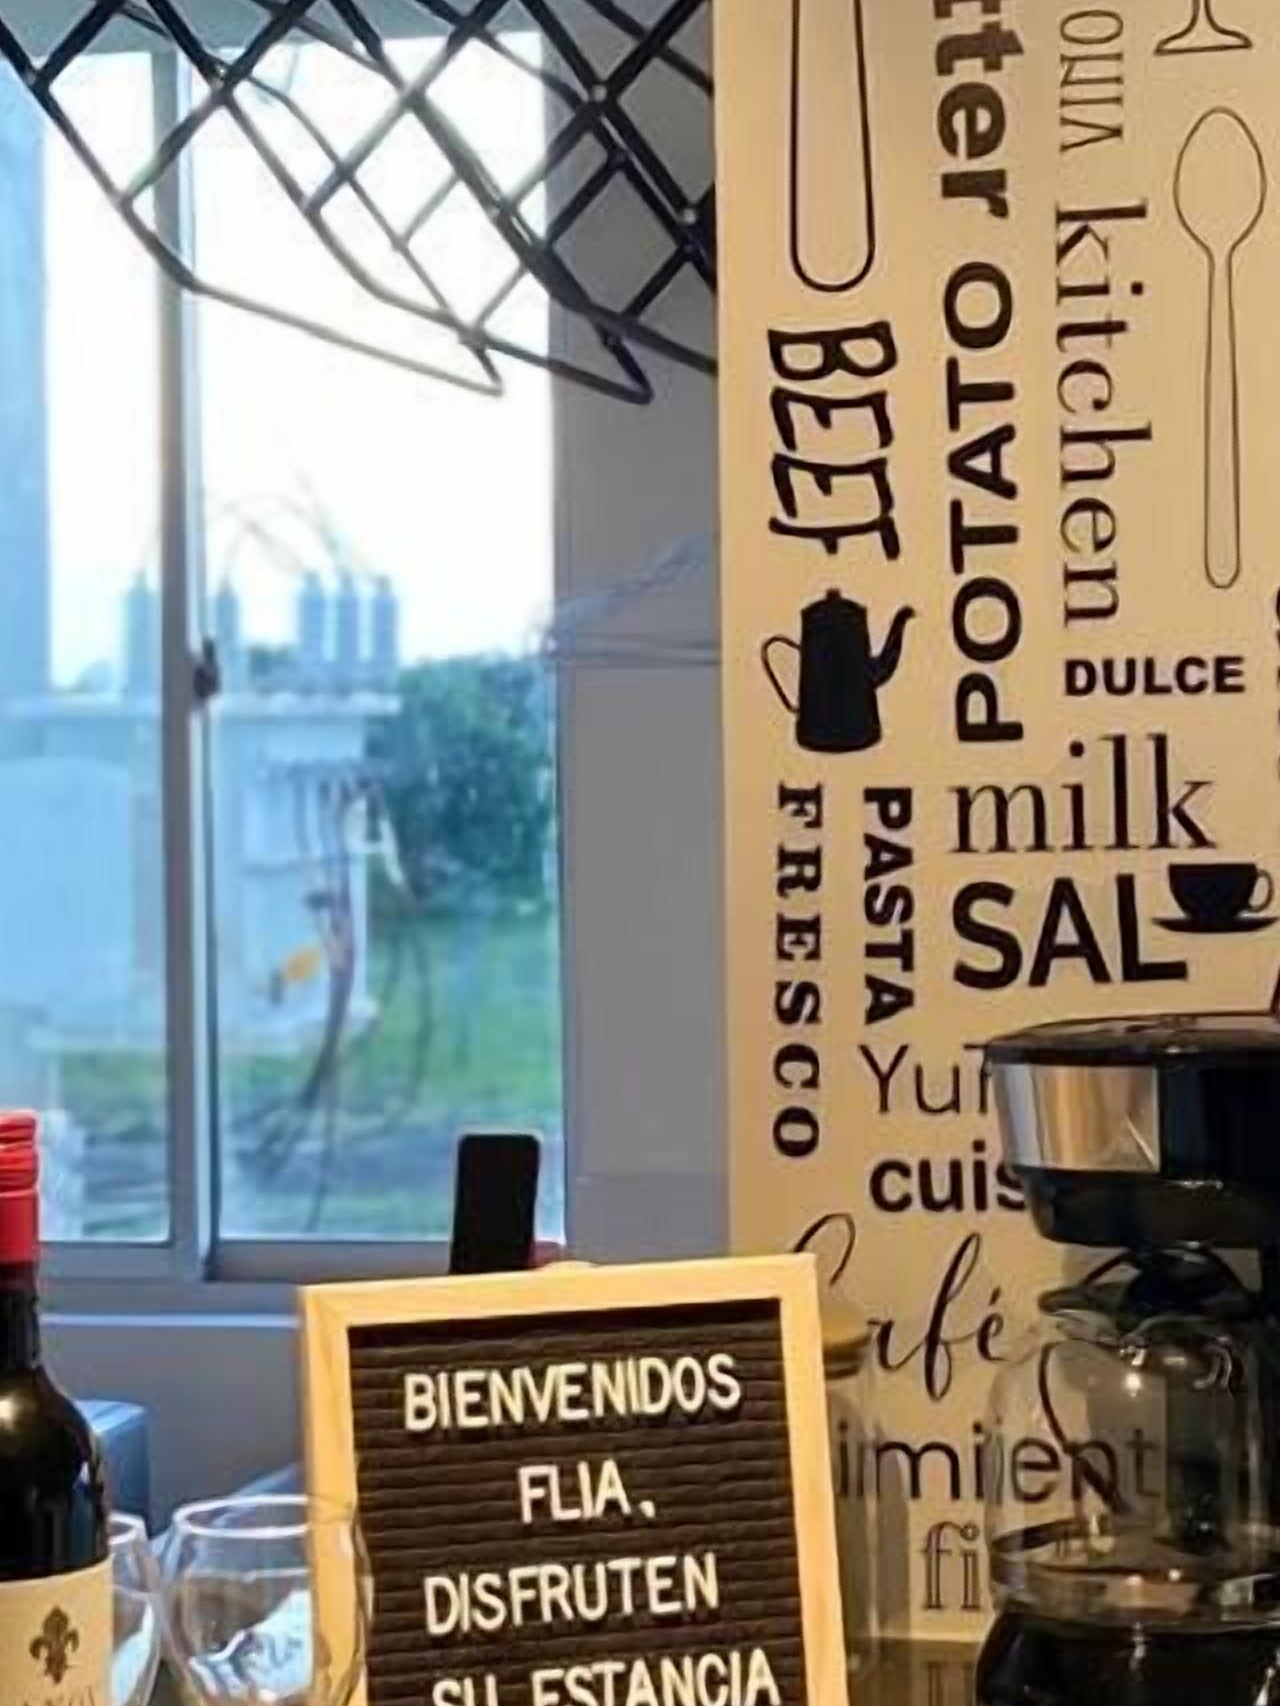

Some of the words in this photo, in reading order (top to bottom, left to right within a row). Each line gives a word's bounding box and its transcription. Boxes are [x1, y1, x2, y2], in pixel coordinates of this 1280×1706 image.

[767, 320, 900, 561] BEEF
[1055, 202, 1152, 627] kitchen
[944, 261, 1024, 742] POTATO
[1064, 655, 1246, 697] DULCE
[947, 734, 1219, 854] milk
[862, 786, 915, 1025] PASTA
[952, 873, 1188, 989] SAL
[773, 782, 824, 1157] FRESCO
[857, 1043, 988, 1117] Yu
[404, 1352, 742, 1431] BIENVENIDOS
[519, 1459, 656, 1524] FLIA.
[424, 1552, 719, 1636] DISFRUTEN
